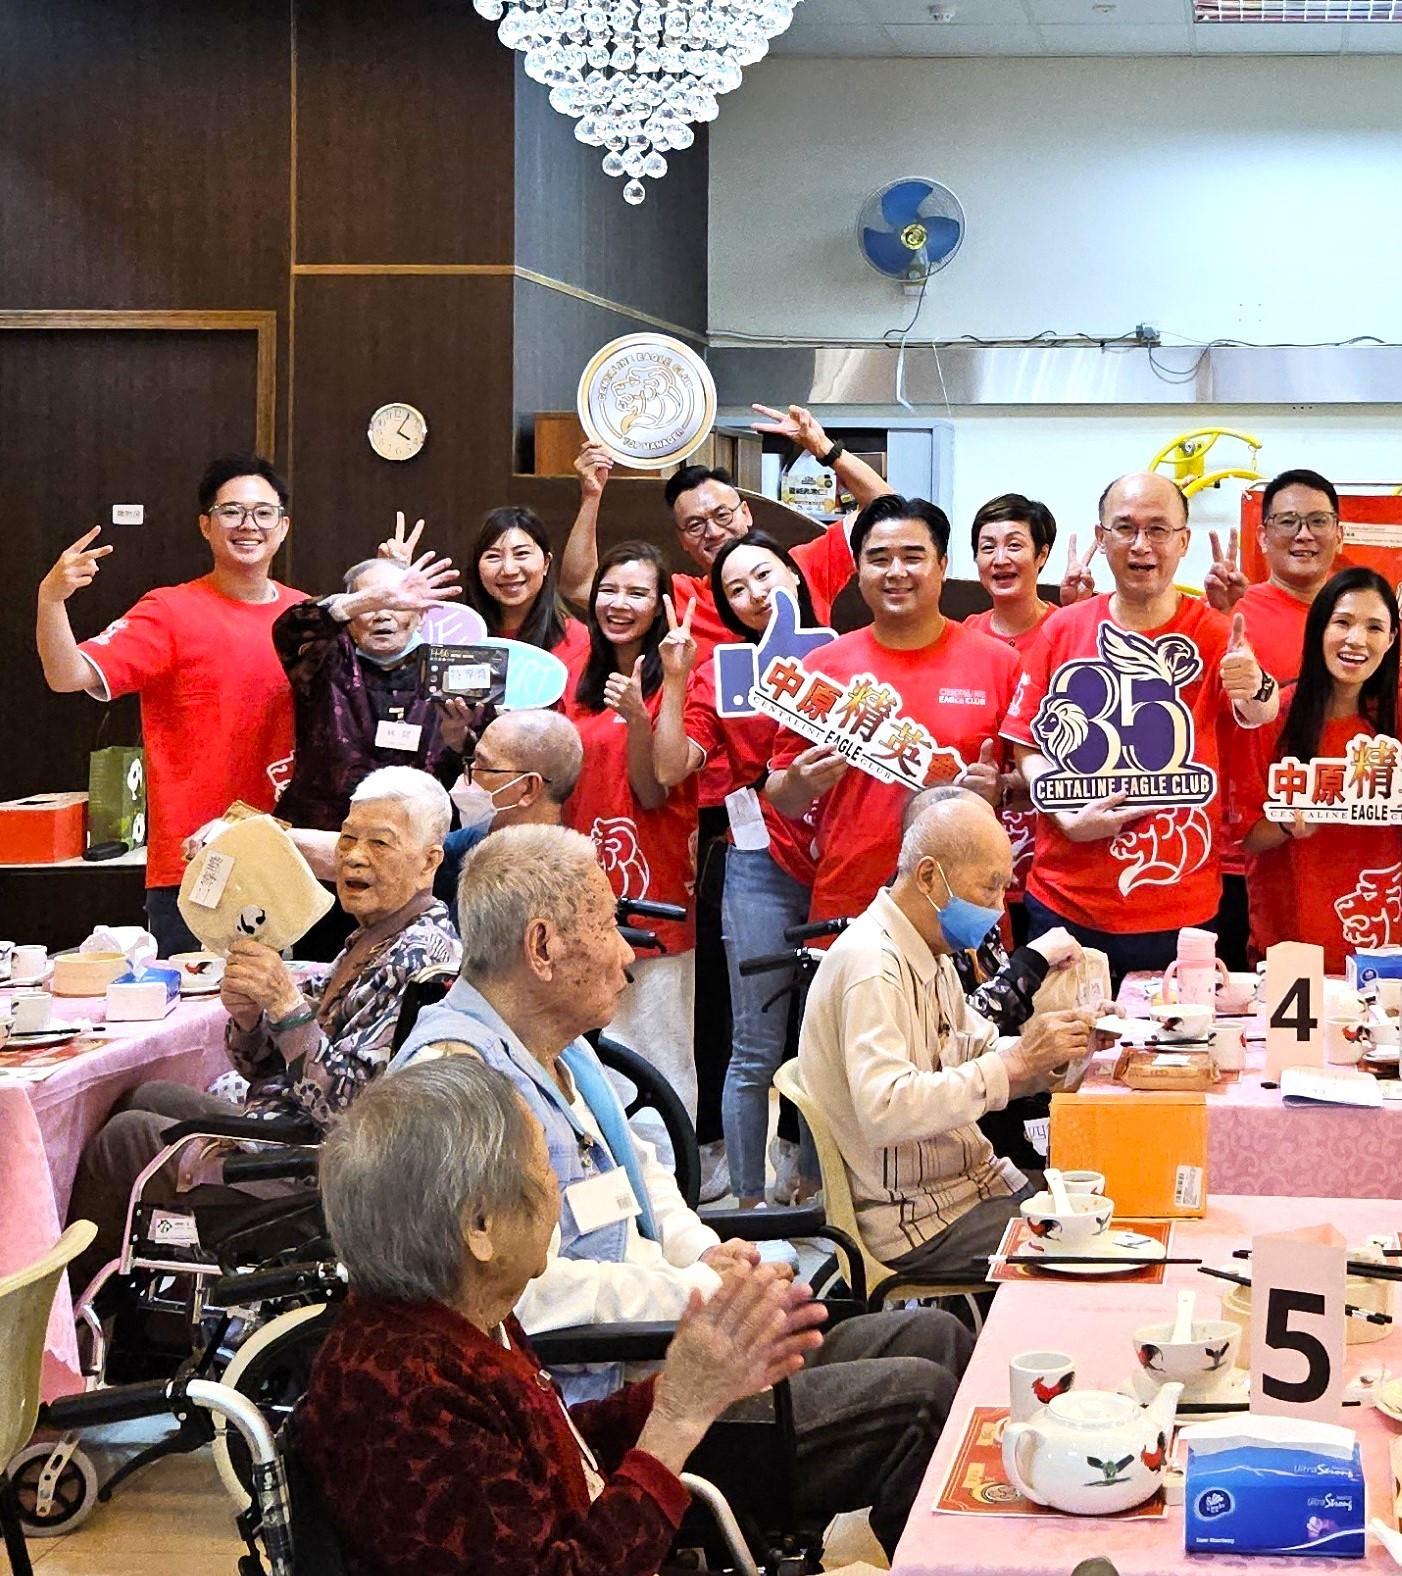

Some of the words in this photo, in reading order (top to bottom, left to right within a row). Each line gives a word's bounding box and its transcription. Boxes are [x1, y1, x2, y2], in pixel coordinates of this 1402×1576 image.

[753, 696, 824, 739] CENTALINE
[824, 730, 864, 763] EAGLE
[860, 757, 892, 780] CLUB
[1054, 666, 1186, 775] 35
[1036, 778, 1117, 800] CENTALINE
[1121, 776, 1167, 796] EAGLE
[1171, 774, 1210, 794] CLUB
[1351, 804, 1388, 821] EAGLE
[1269, 977, 1318, 1042] 4
[1262, 1287, 1331, 1403] 5
